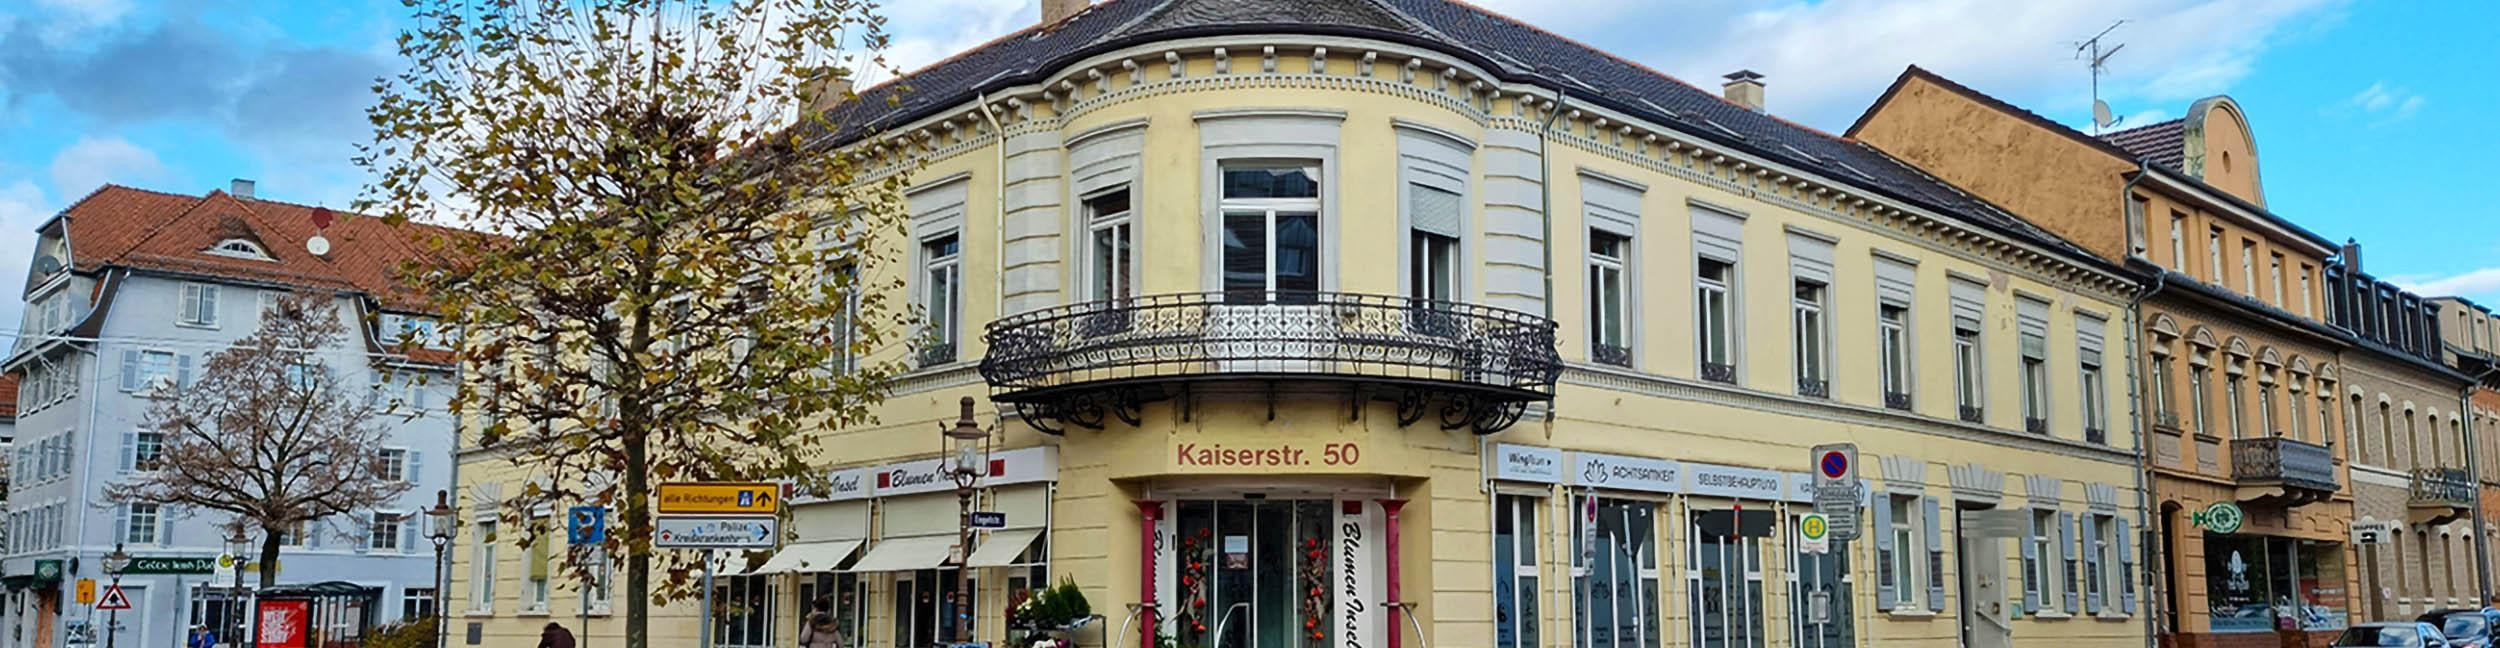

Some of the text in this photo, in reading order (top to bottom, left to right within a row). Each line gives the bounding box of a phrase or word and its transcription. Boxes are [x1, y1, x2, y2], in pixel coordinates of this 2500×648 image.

[1177, 442, 1360, 466] Kaiserstr. 50
[891, 468, 934, 488] Blumen
[1612, 465, 1676, 483] ACHTSAMKEIT
[1697, 472, 1778, 492] SELBSTBEHAUPTUNG
[664, 492, 735, 507] alle Richtungen
[1342, 521, 1364, 648] Blumen Insel
